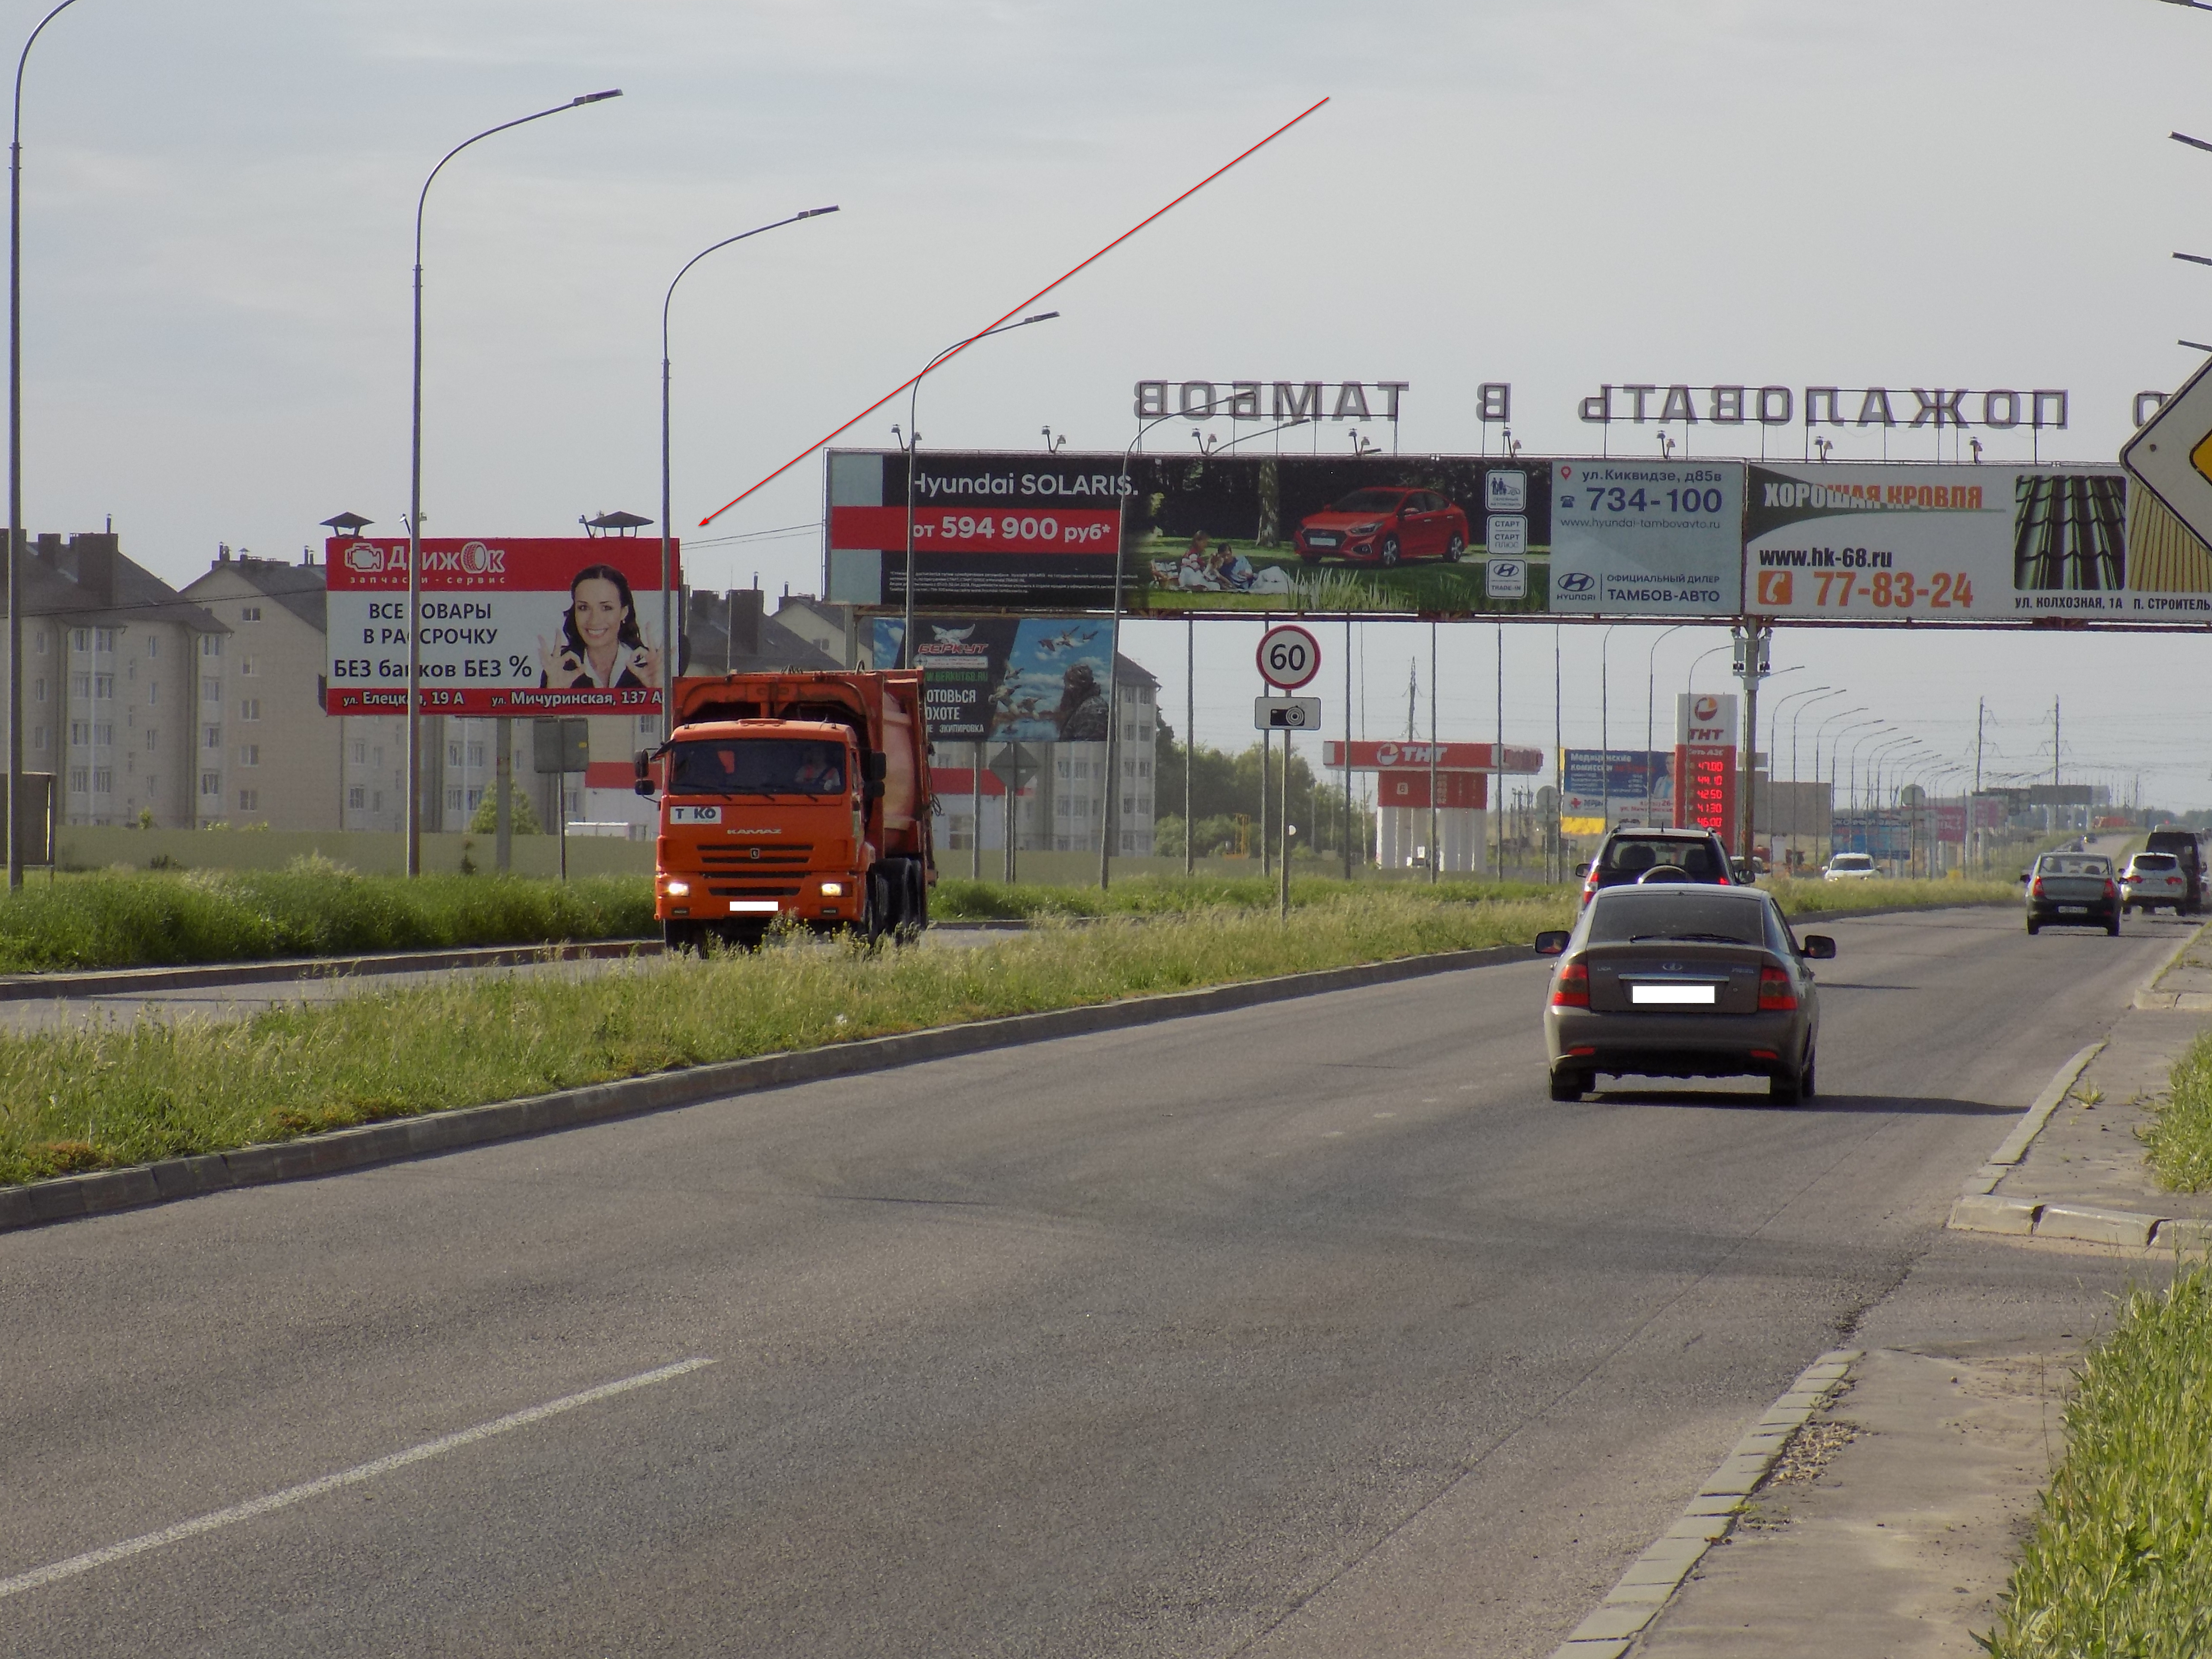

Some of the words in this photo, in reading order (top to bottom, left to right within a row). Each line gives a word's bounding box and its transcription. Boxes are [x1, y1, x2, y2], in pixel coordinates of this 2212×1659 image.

[1021, 474, 1139, 495] SOLARIS.
[1685, 470, 1722, 483] д85в
[1586, 487, 1723, 513] 734-100
[1764, 482, 1881, 509] ХОРОШАЯ
[1887, 484, 1982, 509] КРОВЛЯ
[913, 524, 935, 538] от
[941, 516, 995, 539] 594
[1001, 517, 1058, 540] 900
[1561, 518, 1720, 529] www.hyundai-tambovavto.ru
[1759, 547, 1893, 567] www.hk-68.ru
[447, 576, 505, 586] сервис
[1607, 574, 1685, 583] ОФИЦИАЛЬНЫЙ
[1687, 575, 1720, 584] ДИЛЕР
[1607, 589, 1720, 602] ТАМБОВ-АВТО
[1814, 571, 1973, 608] 77-83-24
[369, 603, 404, 619] ВСЕ
[419, 603, 491, 619] ОВАРЫ
[2015, 597, 2033, 608] УЛ.
[2036, 597, 2105, 609] КОЛХОЗНАЯ,
[2109, 598, 2123, 609] 1А
[2133, 598, 2144, 609] П.
[363, 628, 375, 644] В
[382, 628, 498, 644] РАСРОЧКУ
[918, 643, 989, 654] БЕРКУТ
[1270, 643, 1306, 671] 60
[334, 659, 371, 677] БЕЗ
[464, 659, 501, 677] БЕЗ
[509, 655, 532, 677] %
[343, 695, 358, 706] ул.
[432, 692, 449, 705] 19
[453, 692, 465, 705] А
[492, 696, 506, 706] ул.
[510, 691, 616, 708] Мичуринская,
[621, 691, 647, 705] 137
[651, 691, 662, 705] А
[927, 689, 976, 703] ОТОВЬСЯ
[939, 723, 984, 733] ЭКИПИРОВКА
